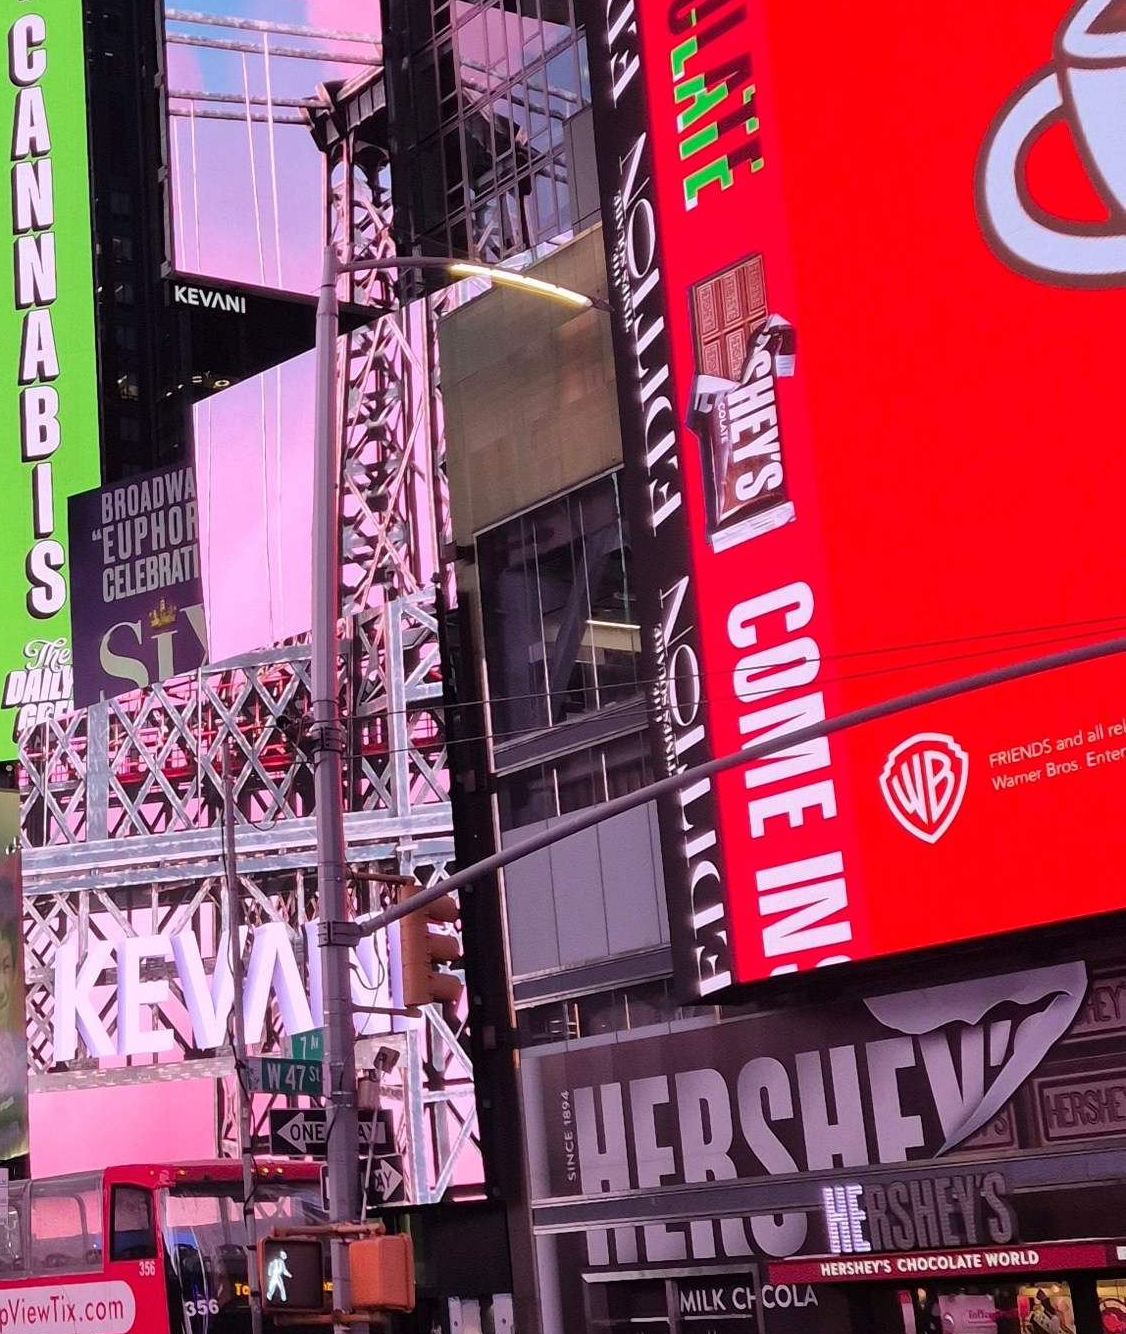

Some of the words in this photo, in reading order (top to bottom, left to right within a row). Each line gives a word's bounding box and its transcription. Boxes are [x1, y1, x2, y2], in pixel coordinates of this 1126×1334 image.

[10, 13, 67, 617] CANNABIS
[619, 131, 682, 537] EDITION
[24, 637, 70, 672] The
[4, 665, 74, 707] DAILY
[727, 581, 836, 840] COME
[989, 738, 1052, 769] FRIENDS
[1056, 729, 1083, 751] and
[1087, 723, 1104, 743] all
[659, 575, 733, 997] EDITION
[891, 749, 956, 826] WB
[991, 769, 1043, 791] Warner
[1045, 762, 1082, 778] Bros.
[301, 1036, 307, 1060] 7
[267, 1063, 281, 1090] W
[285, 1064, 307, 1091] 47
[309, 1066, 320, 1083] St
[560, 1090, 572, 1127] 1894
[290, 1124, 325, 1142] ONE
[564, 1129, 577, 1181] SINCE
[823, 1171, 1013, 1254] HERSHEY'S
[139, 1260, 155, 1277] 356
[820, 1259, 892, 1276] HERSHEY'S
[896, 1253, 982, 1273] CHOCOLATE
[984, 1250, 1039, 1267] WORLD
[185, 1298, 219, 1317] 356
[680, 1288, 727, 1313] MILK
